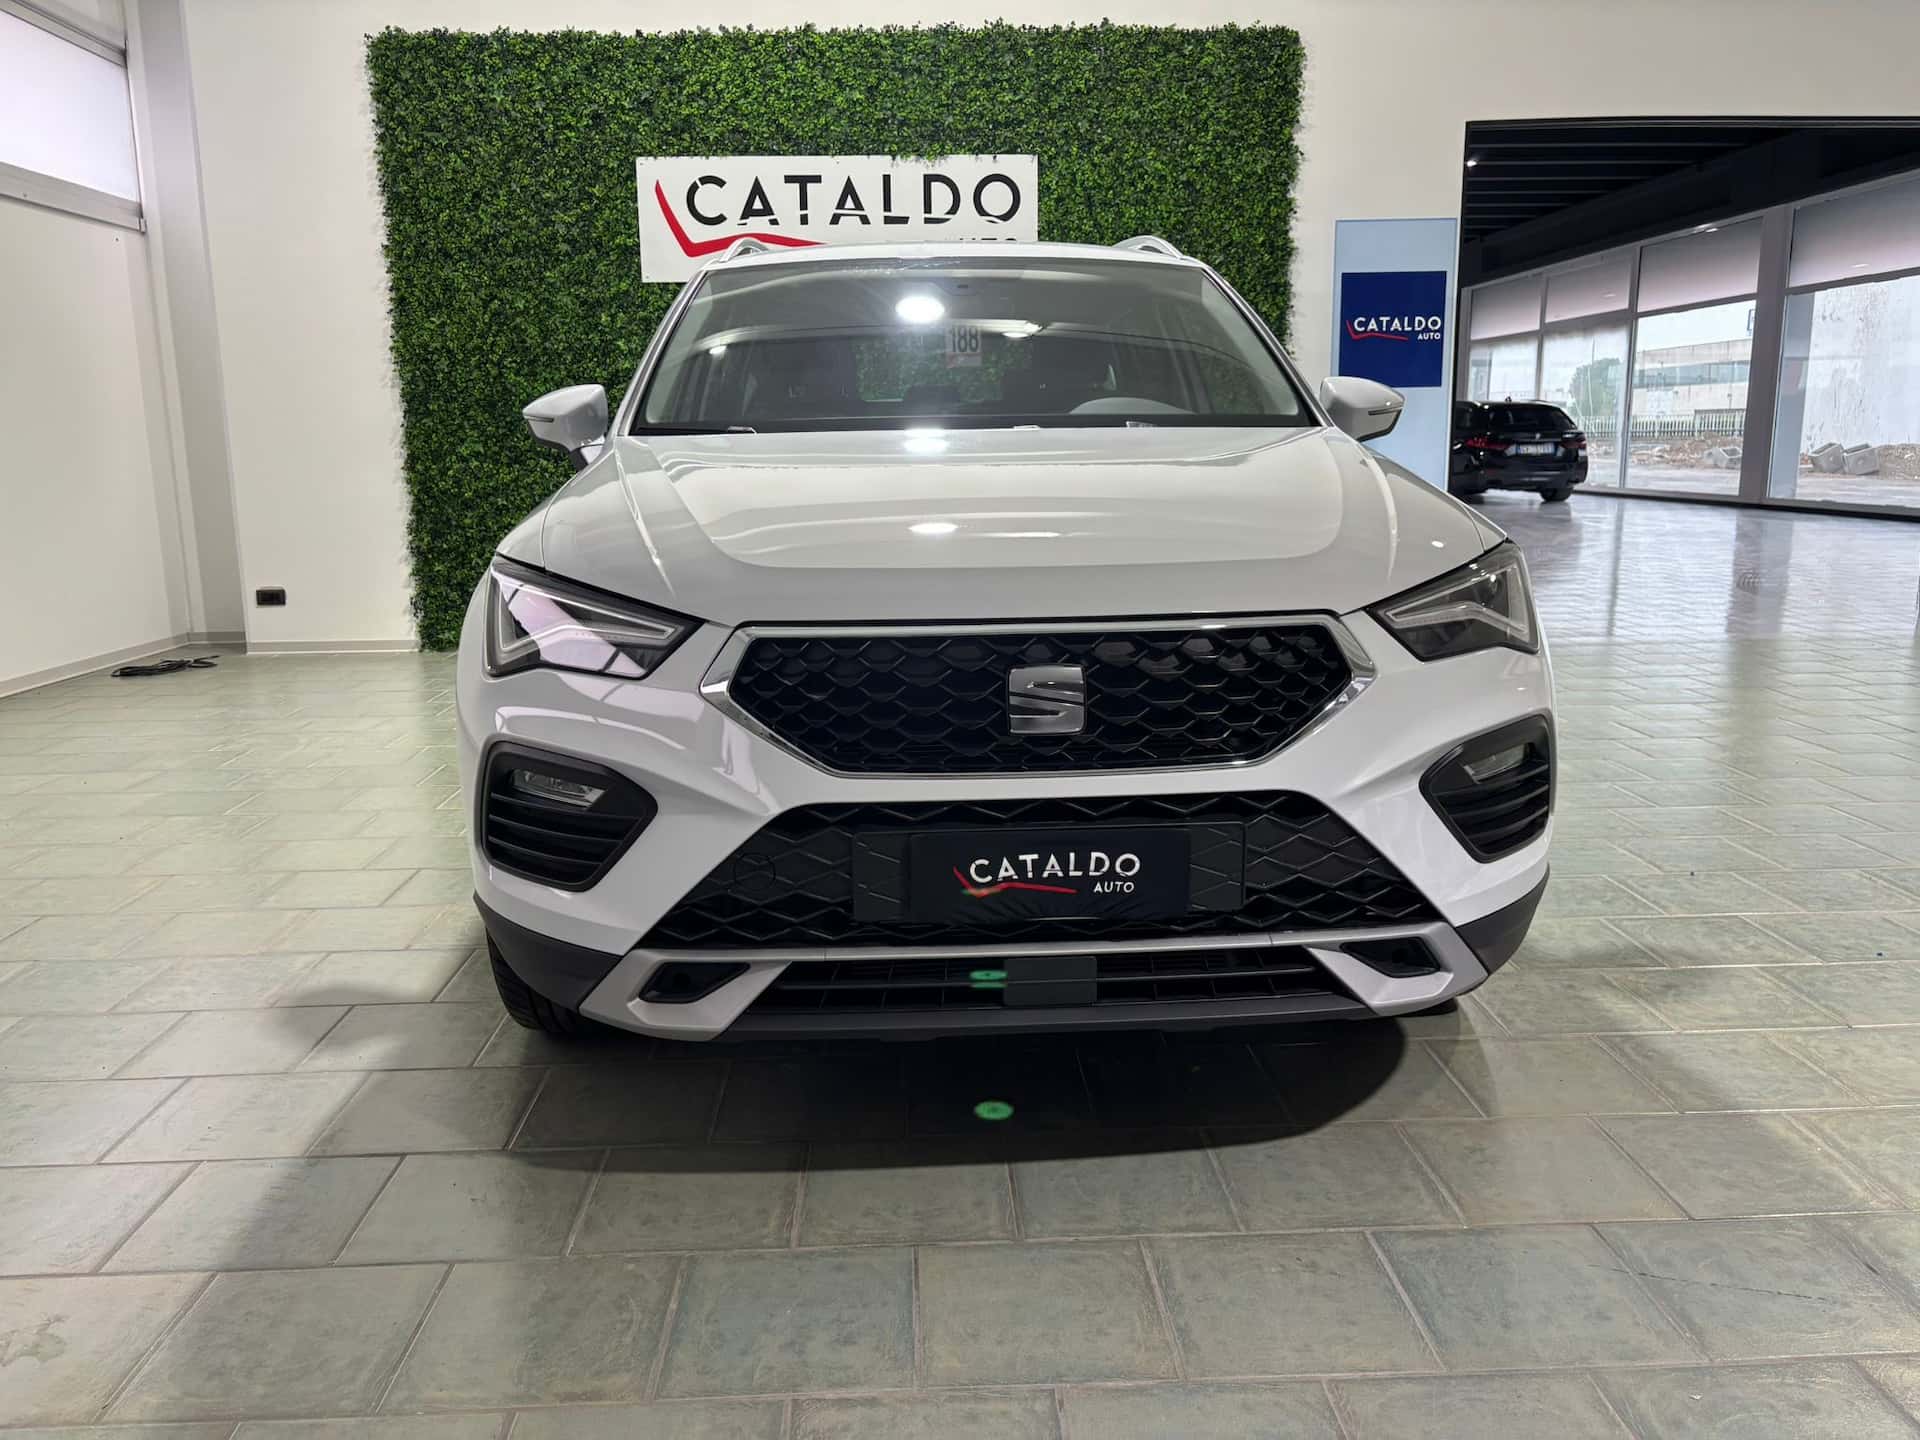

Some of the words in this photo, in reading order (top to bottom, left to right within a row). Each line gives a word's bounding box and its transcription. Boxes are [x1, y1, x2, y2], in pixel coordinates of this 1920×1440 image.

[686, 173, 1021, 225] CATALDO
[1354, 316, 1441, 331] CATALDO
[949, 325, 979, 353] 188
[1417, 333, 1441, 341] AUTO
[970, 852, 1140, 883] CATALDO
[1093, 881, 1135, 893] AUTO
